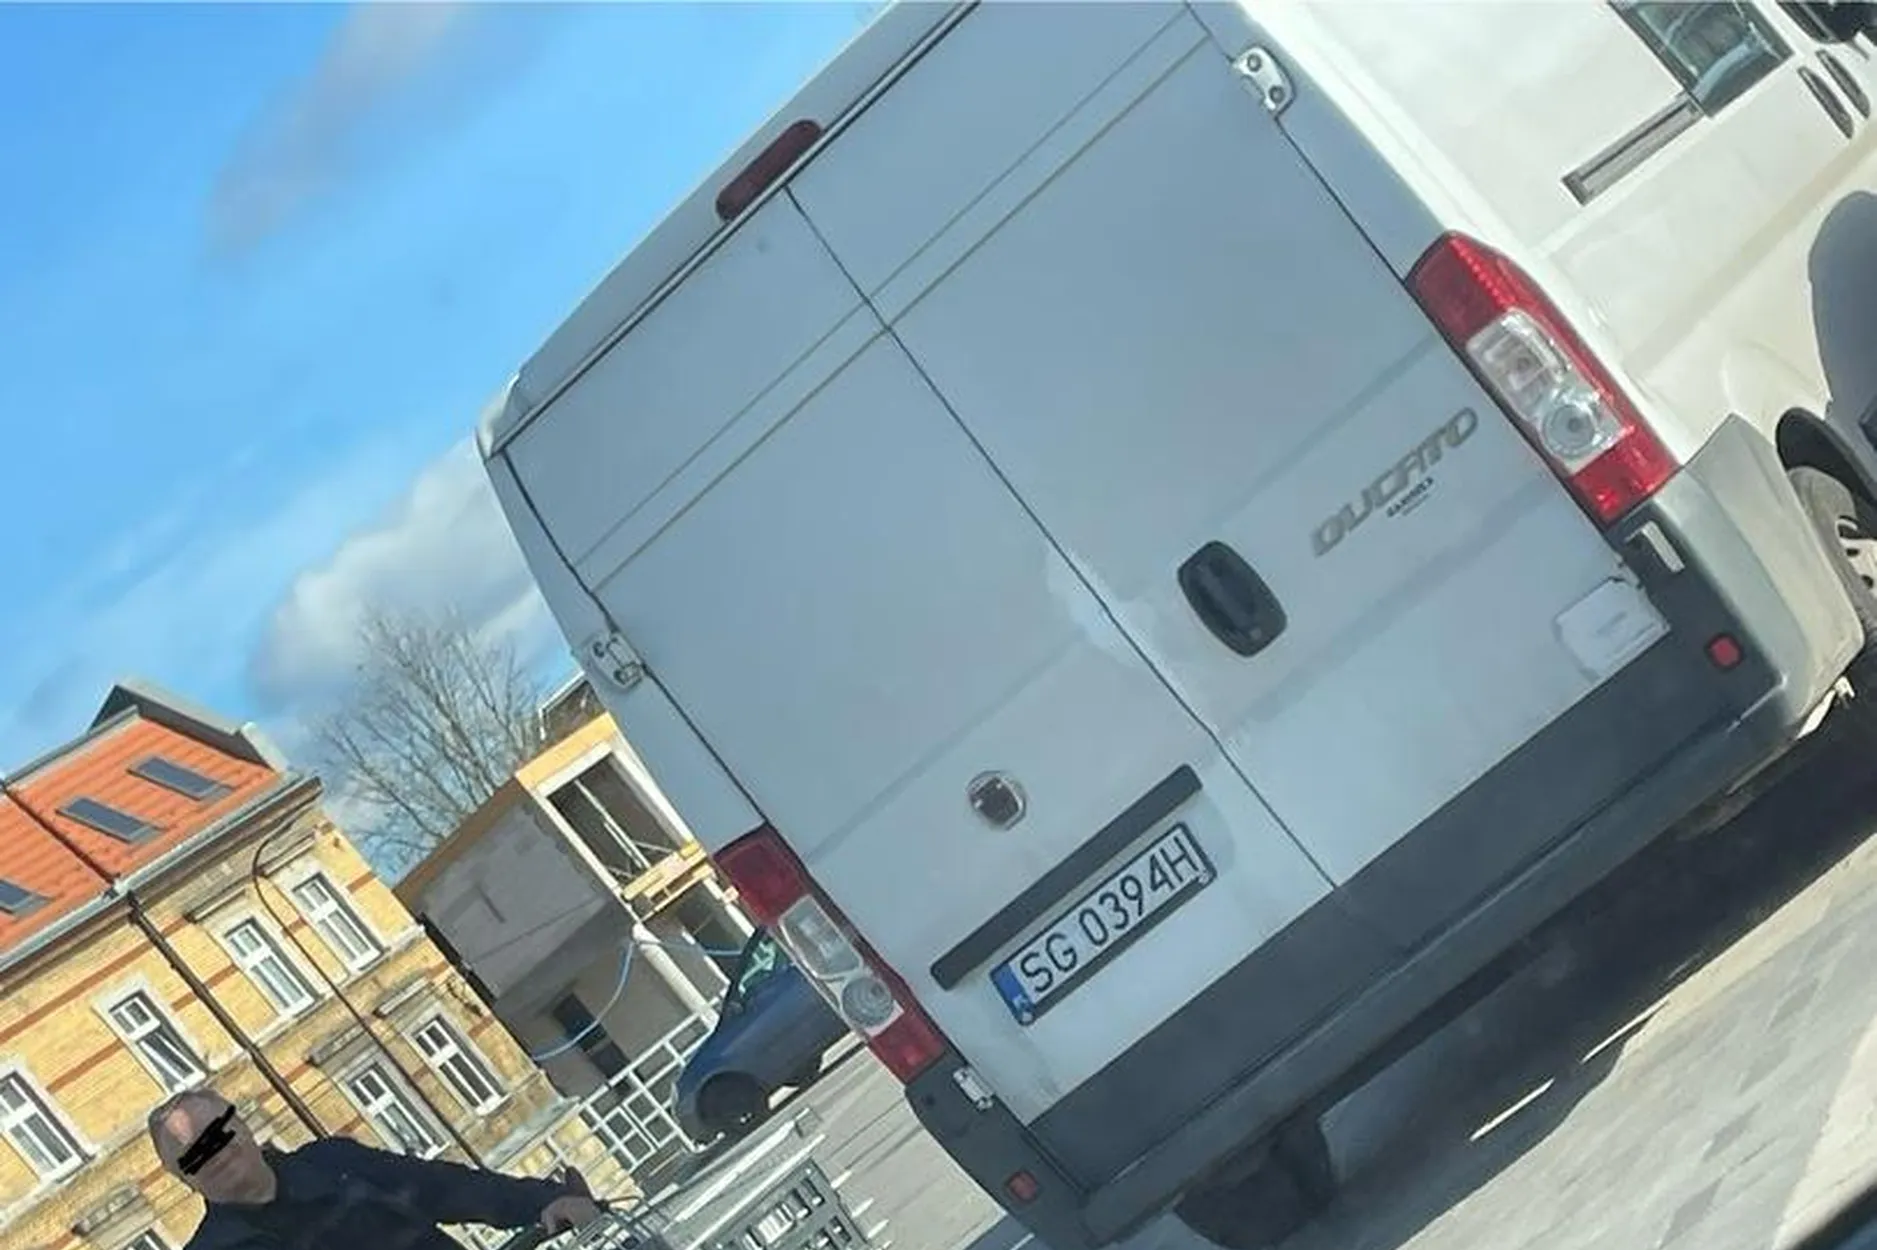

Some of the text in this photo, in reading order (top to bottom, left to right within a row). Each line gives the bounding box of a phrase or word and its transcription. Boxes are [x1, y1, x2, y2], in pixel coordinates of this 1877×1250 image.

[1311, 406, 1479, 558] DUCATO
[1019, 835, 1200, 994] SG 0394H
